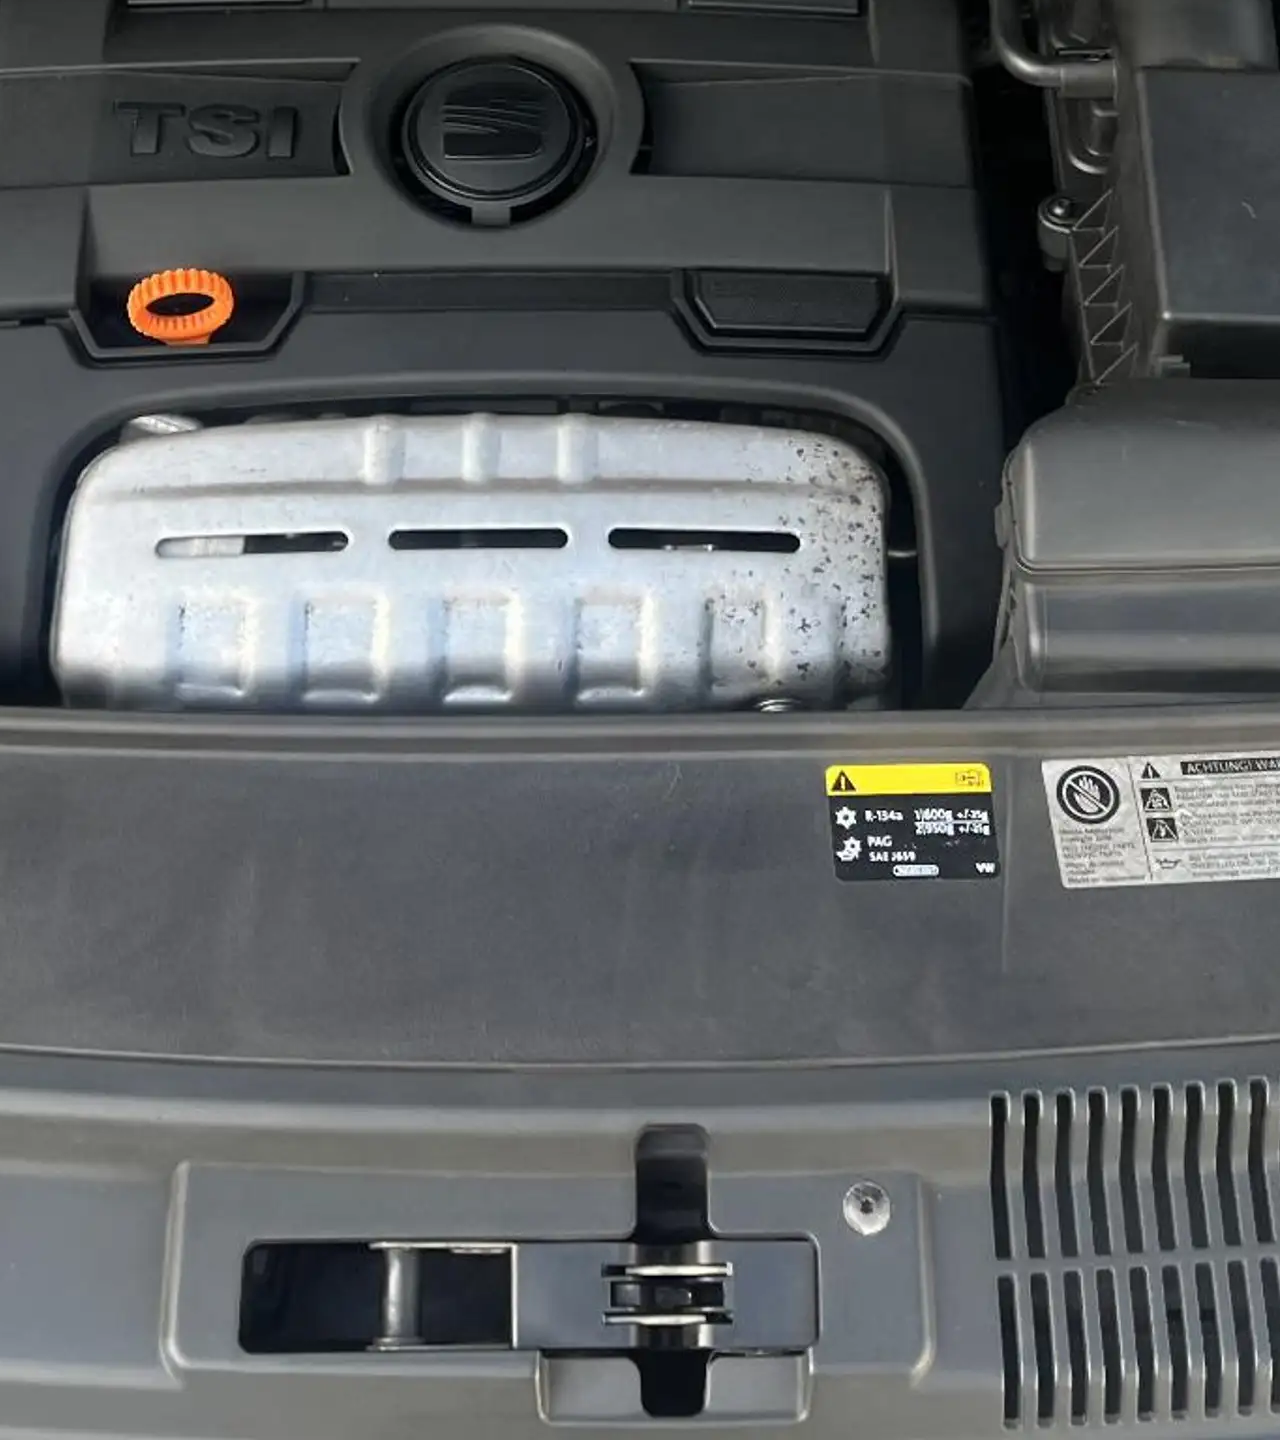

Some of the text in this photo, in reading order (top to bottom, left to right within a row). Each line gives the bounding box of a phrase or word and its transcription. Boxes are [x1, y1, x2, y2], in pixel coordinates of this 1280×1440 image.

[113, 102, 297, 159] TSI
[1186, 760, 1251, 774] ACHTUNG!
[864, 809, 904, 822] R-134a
[866, 835, 893, 847] PAG
[869, 851, 889, 862] SAE
[975, 862, 996, 873] VW
